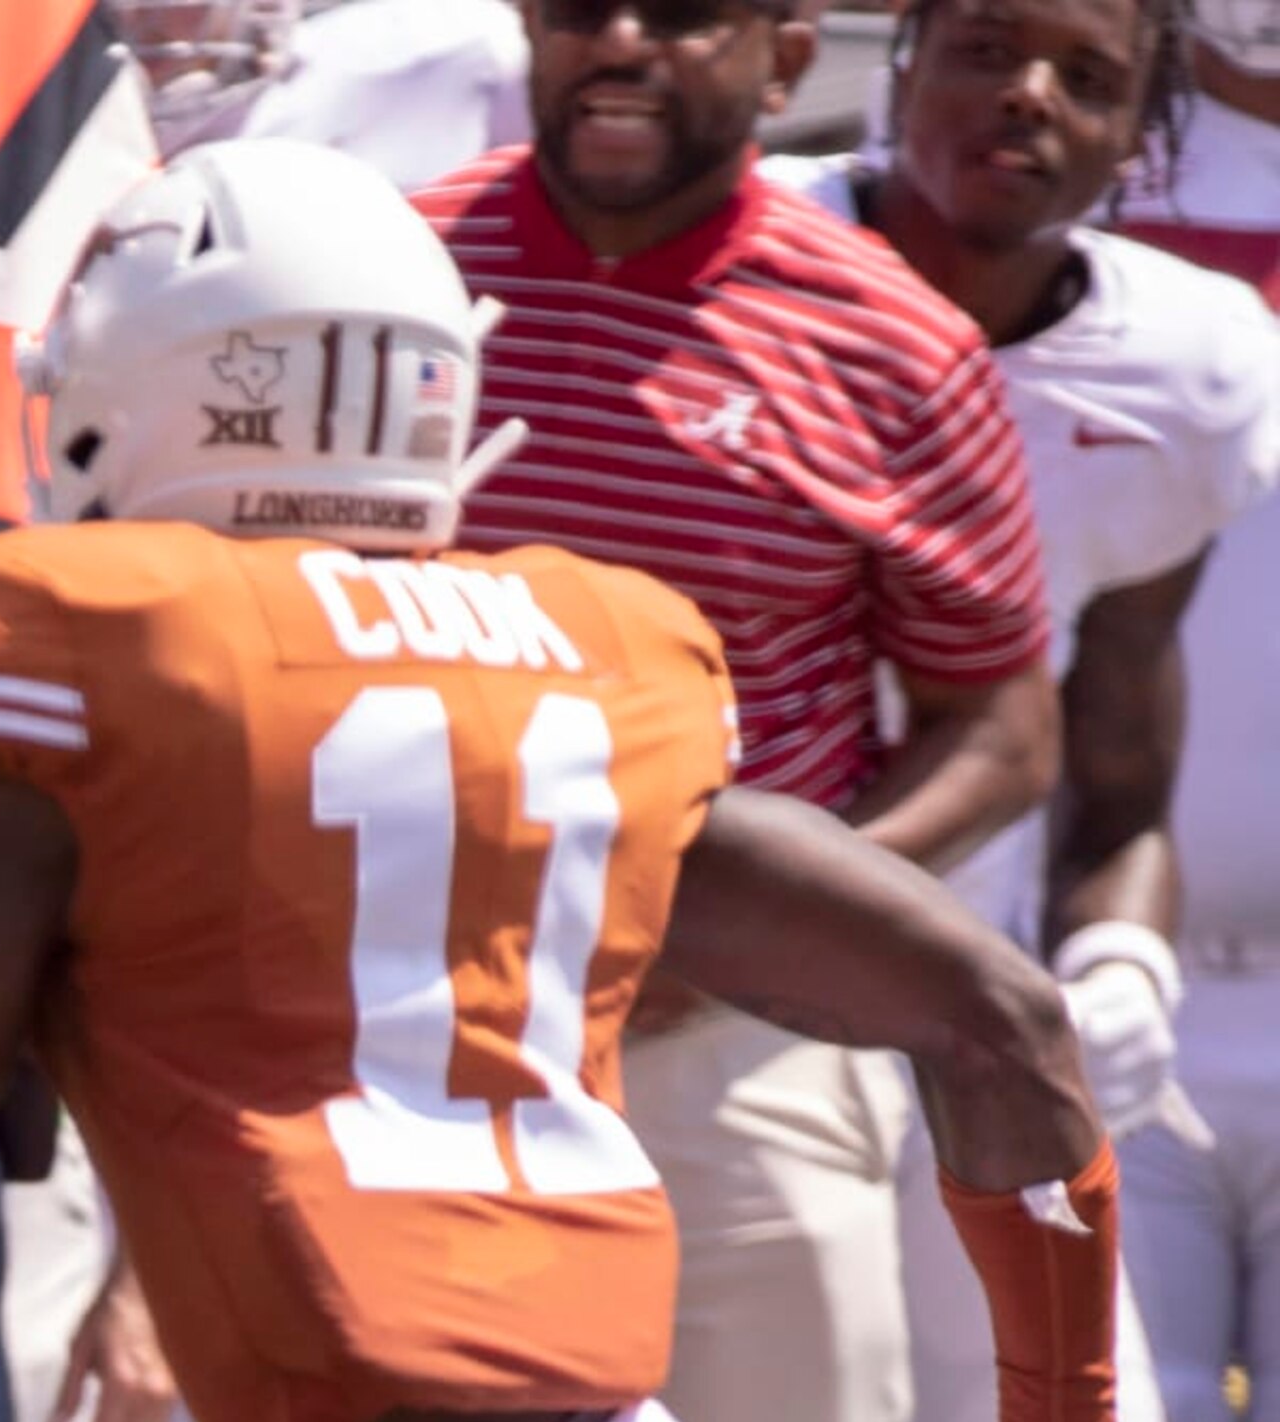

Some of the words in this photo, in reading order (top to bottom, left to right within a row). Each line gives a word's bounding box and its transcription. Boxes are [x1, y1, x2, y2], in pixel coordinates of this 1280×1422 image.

[198, 404, 283, 449] XII
[316, 321, 393, 455] 11
[232, 490, 429, 532] LONGHORNS
[298, 549, 584, 672] COOK
[312, 685, 662, 1194] 11
